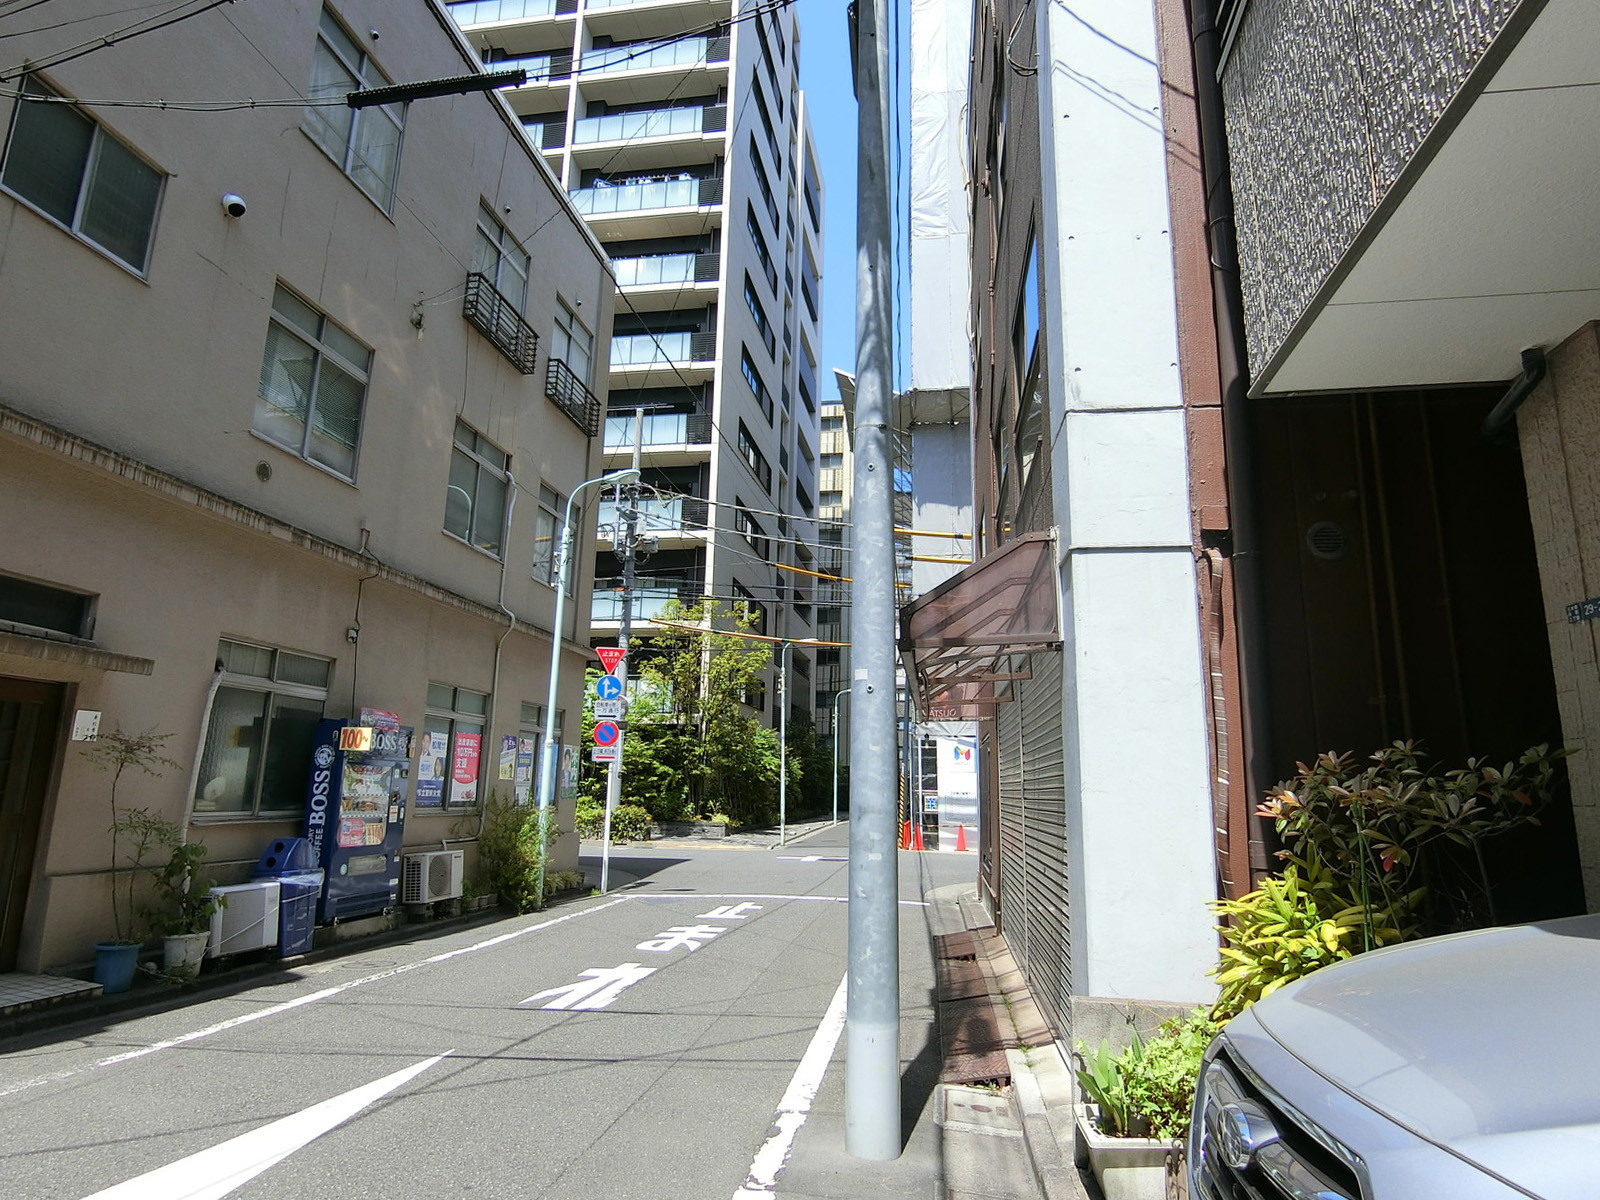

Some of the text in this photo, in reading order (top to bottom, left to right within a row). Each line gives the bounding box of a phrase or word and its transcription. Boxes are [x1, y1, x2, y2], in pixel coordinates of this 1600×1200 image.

[371, 733, 397, 751] BOSS
[309, 770, 331, 826] BOSS
[518, 901, 763, 1010] 止まれ
